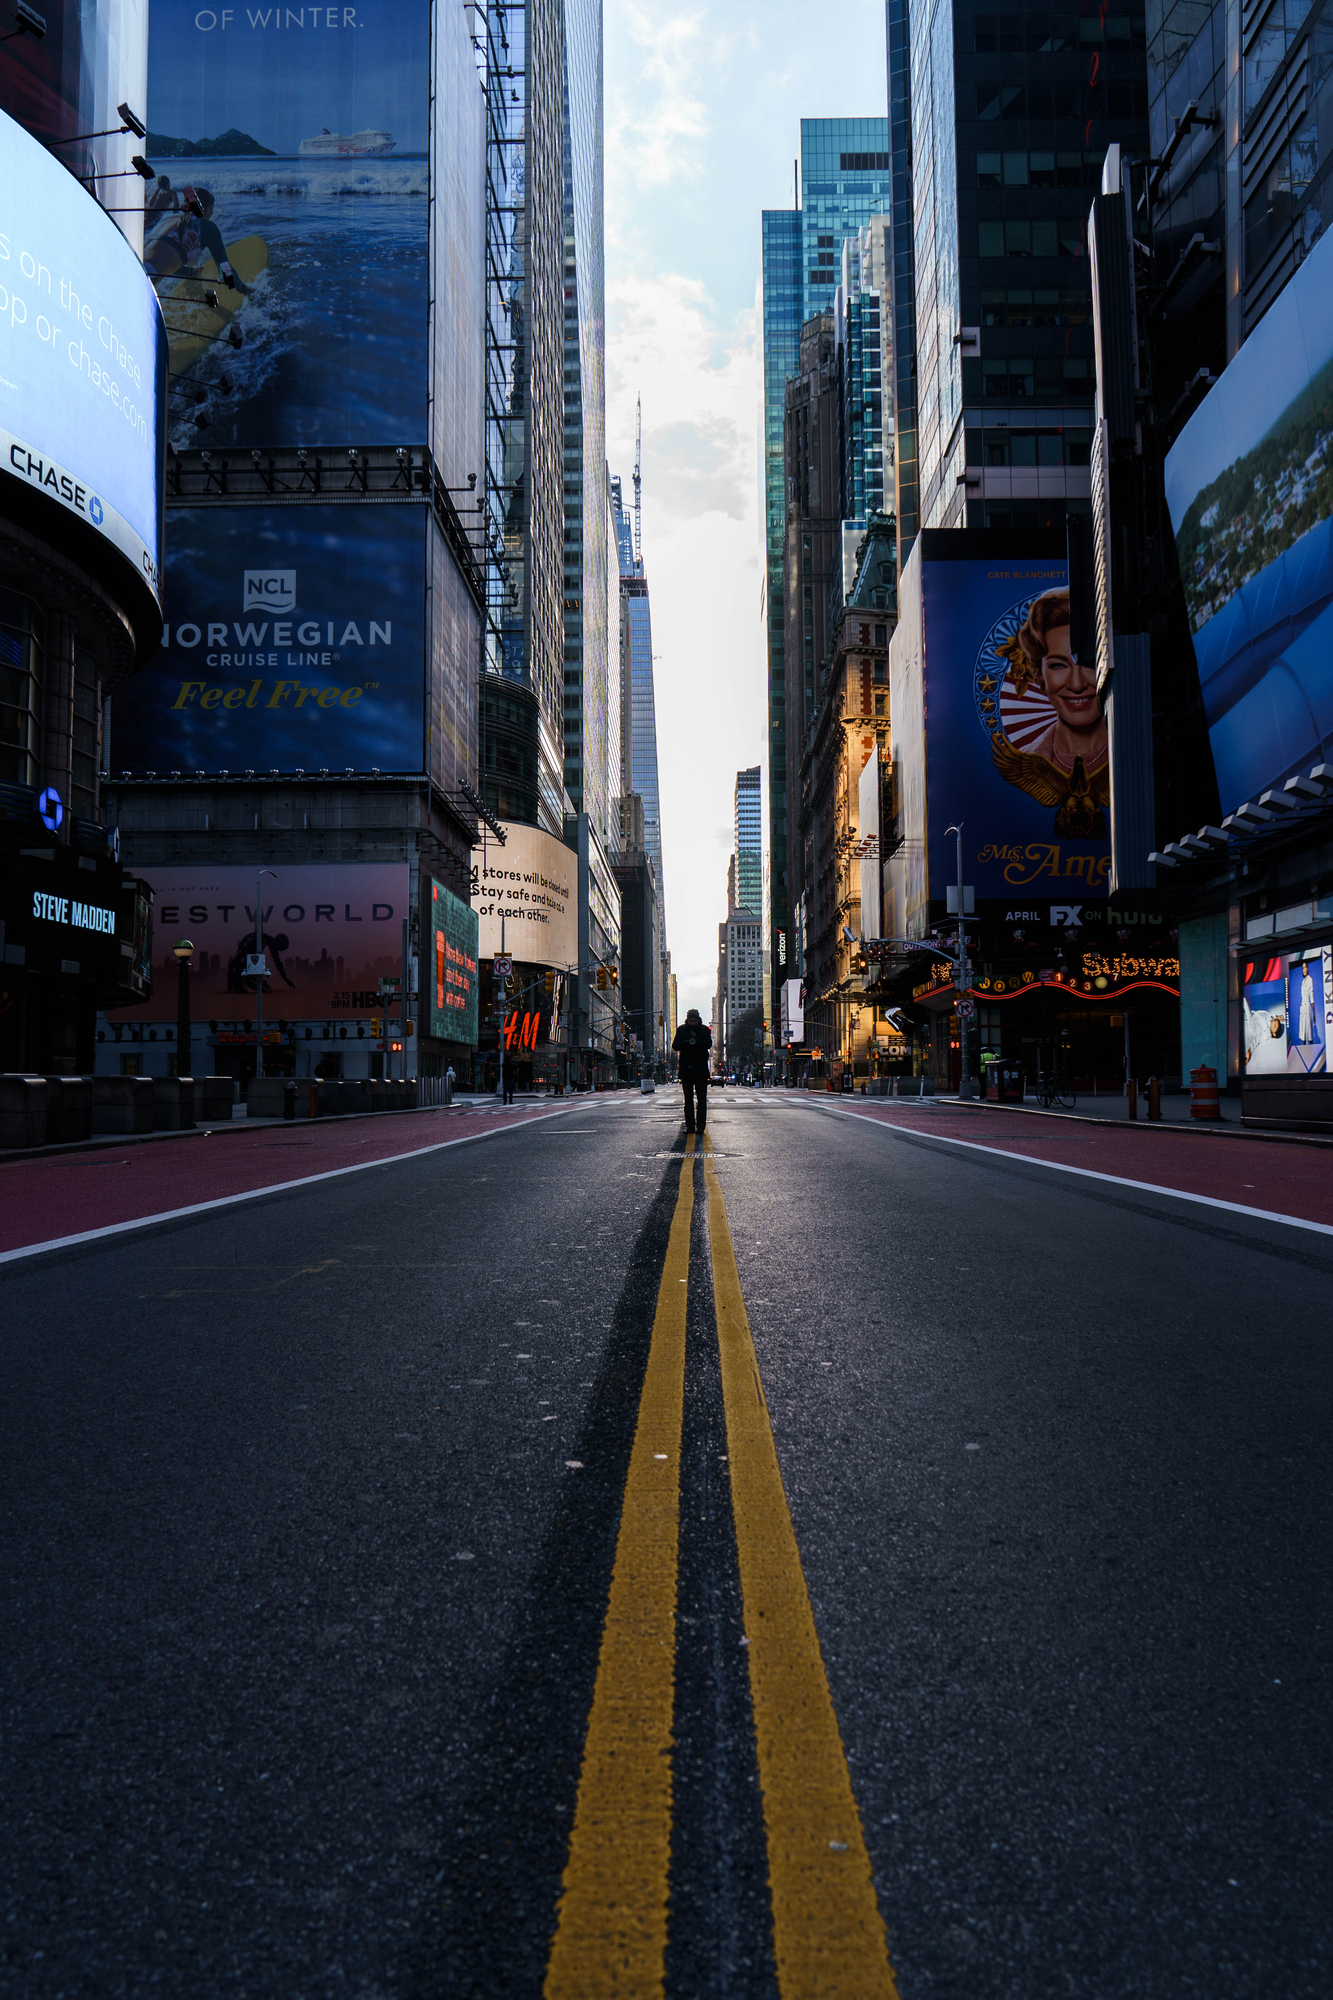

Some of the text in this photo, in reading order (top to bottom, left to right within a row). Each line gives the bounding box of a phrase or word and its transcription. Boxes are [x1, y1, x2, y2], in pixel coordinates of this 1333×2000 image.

[194, 7, 364, 31] OF WINTER.
[19, 251, 52, 294] on
[59, 277, 93, 331] the
[98, 316, 141, 389] Chase
[36, 315, 62, 348] or
[68, 340, 148, 444] chase.com
[10, 443, 87, 512] CHASE
[247, 578, 292, 595] NCL
[987, 571, 1066, 579] CATE BLANCHETT
[206, 653, 278, 667] CRUISE
[170, 678, 263, 710] Feel
[977, 843, 1112, 886] Mrs. Ame
[482, 867, 521, 882] stores
[523, 872, 540, 885] will
[540, 874, 548, 888] be
[471, 884, 504, 900] Stay
[506, 888, 530, 901] safe
[531, 893, 546, 906] and
[32, 890, 116, 936] STEVE MADDEN
[160, 903, 394, 924] ESTWORLD
[480, 904, 550, 925] of each other.
[1005, 911, 1041, 922] APRIL
[1050, 905, 1084, 926] FX
[1084, 910, 1102, 921] ON
[778, 933, 787, 966] verizon
[1081, 952, 1181, 977] Subwa
[333, 991, 350, 1000] 3.15
[1323, 949, 1333, 1025] DKNY
[331, 1000, 350, 1009] 9PM
[352, 991, 392, 1008] HBO
[497, 1011, 540, 1051] H&M
